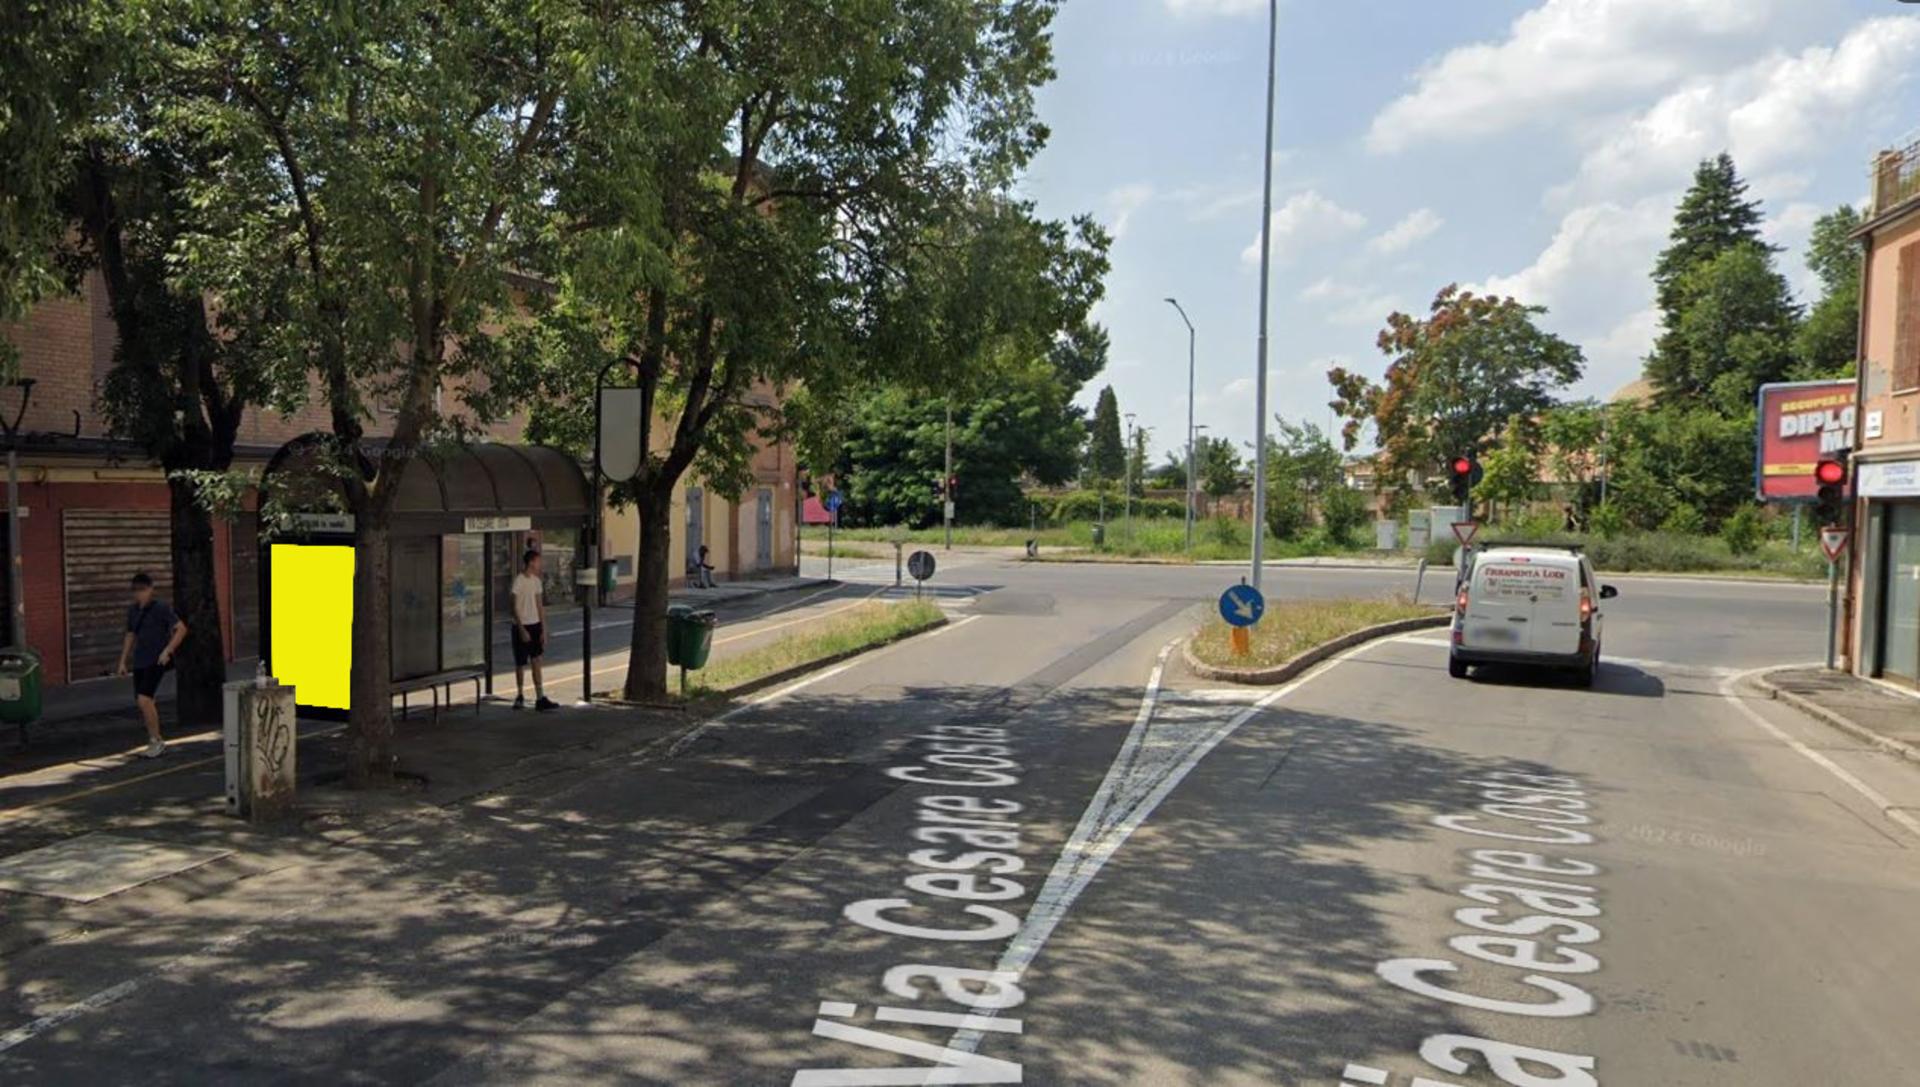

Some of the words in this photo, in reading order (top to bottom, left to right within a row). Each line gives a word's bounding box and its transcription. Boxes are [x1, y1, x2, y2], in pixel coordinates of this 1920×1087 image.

[885, 724, 1019, 787] Costa
[1432, 772, 1593, 844] Costa
[843, 795, 1025, 941] Cesare
[1376, 850, 1601, 1017] Cesare
[790, 964, 1025, 1087] Via
[1338, 1033, 1600, 1087] ia
